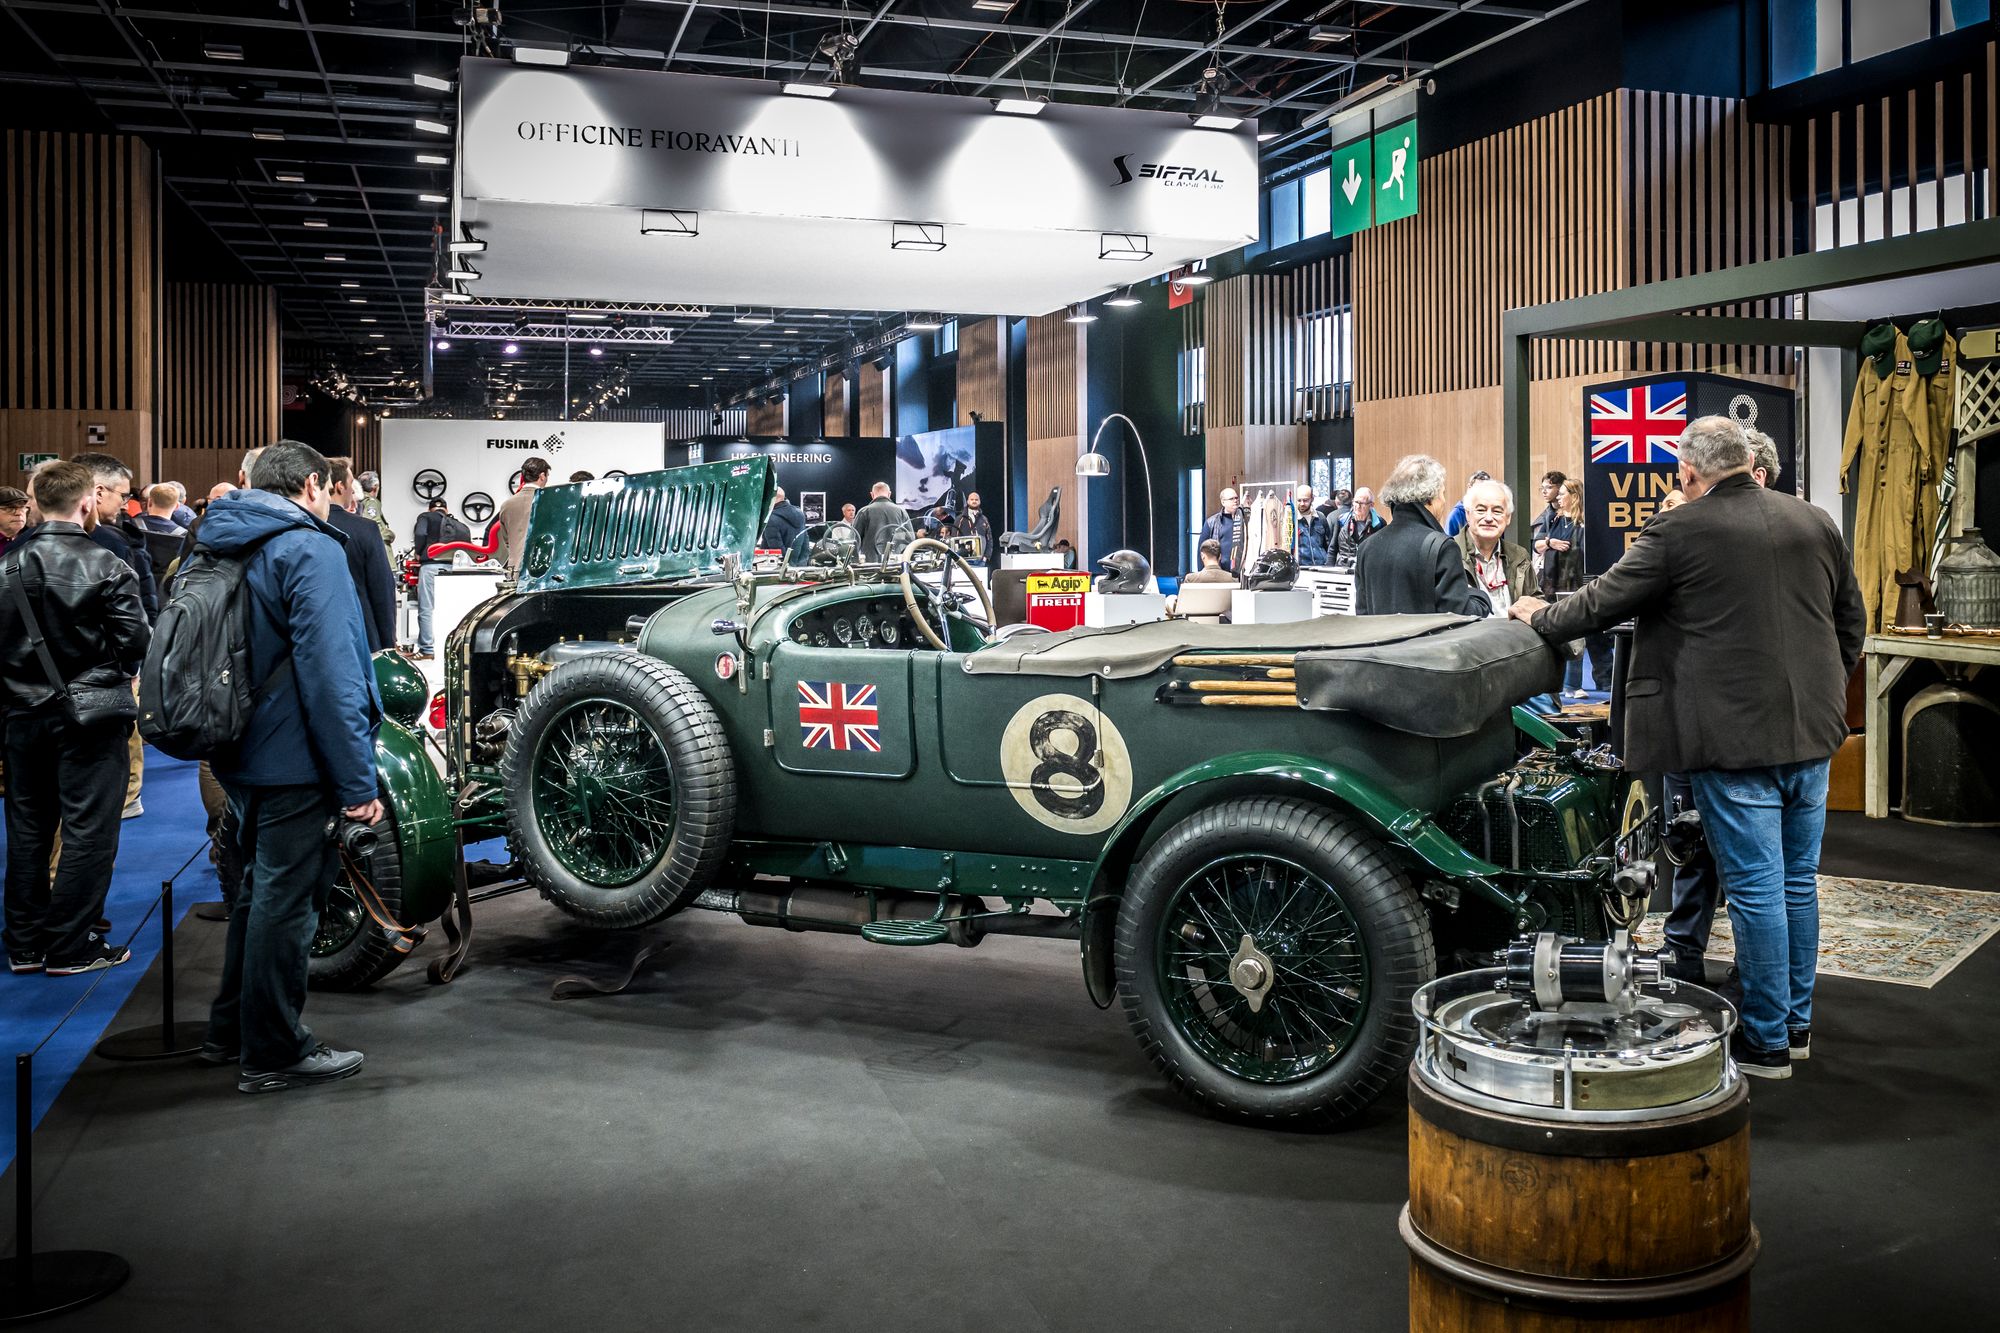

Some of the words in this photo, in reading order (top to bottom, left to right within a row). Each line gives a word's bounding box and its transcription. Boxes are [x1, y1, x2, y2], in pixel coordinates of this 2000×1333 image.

[517, 120, 643, 148] OFFICINE
[1138, 164, 1224, 183] SIFRAL
[486, 439, 540, 449] FUSINA
[1608, 472, 1681, 498] VIN
[1608, 502, 1662, 528] BE
[1051, 576, 1081, 591] Agip
[1031, 593, 1082, 607] PIRELLI
[1030, 710, 1105, 820] 8
